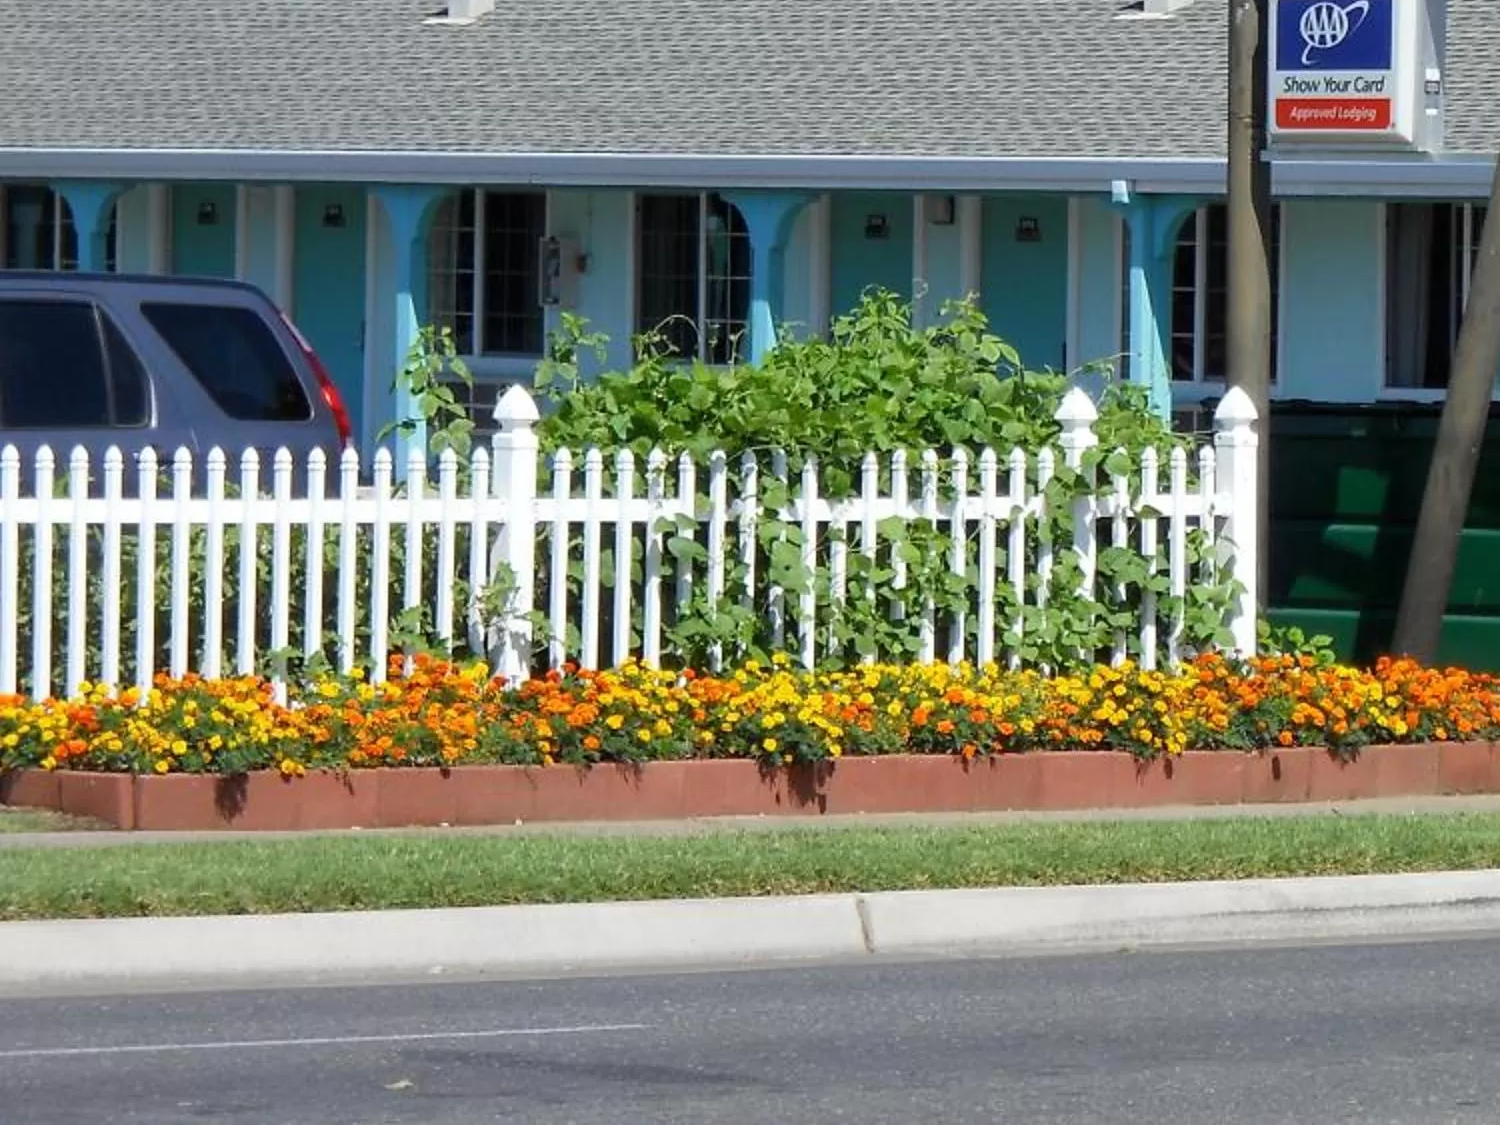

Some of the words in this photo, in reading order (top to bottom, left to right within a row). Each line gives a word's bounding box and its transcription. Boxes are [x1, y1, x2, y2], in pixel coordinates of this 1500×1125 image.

[1303, 3, 1345, 46] AAA
[1283, 76, 1321, 93] Show
[1323, 76, 1352, 93] Your
[1354, 75, 1385, 93] Card
[1289, 106, 1337, 122] Approved
[1338, 106, 1377, 122] Lodging
